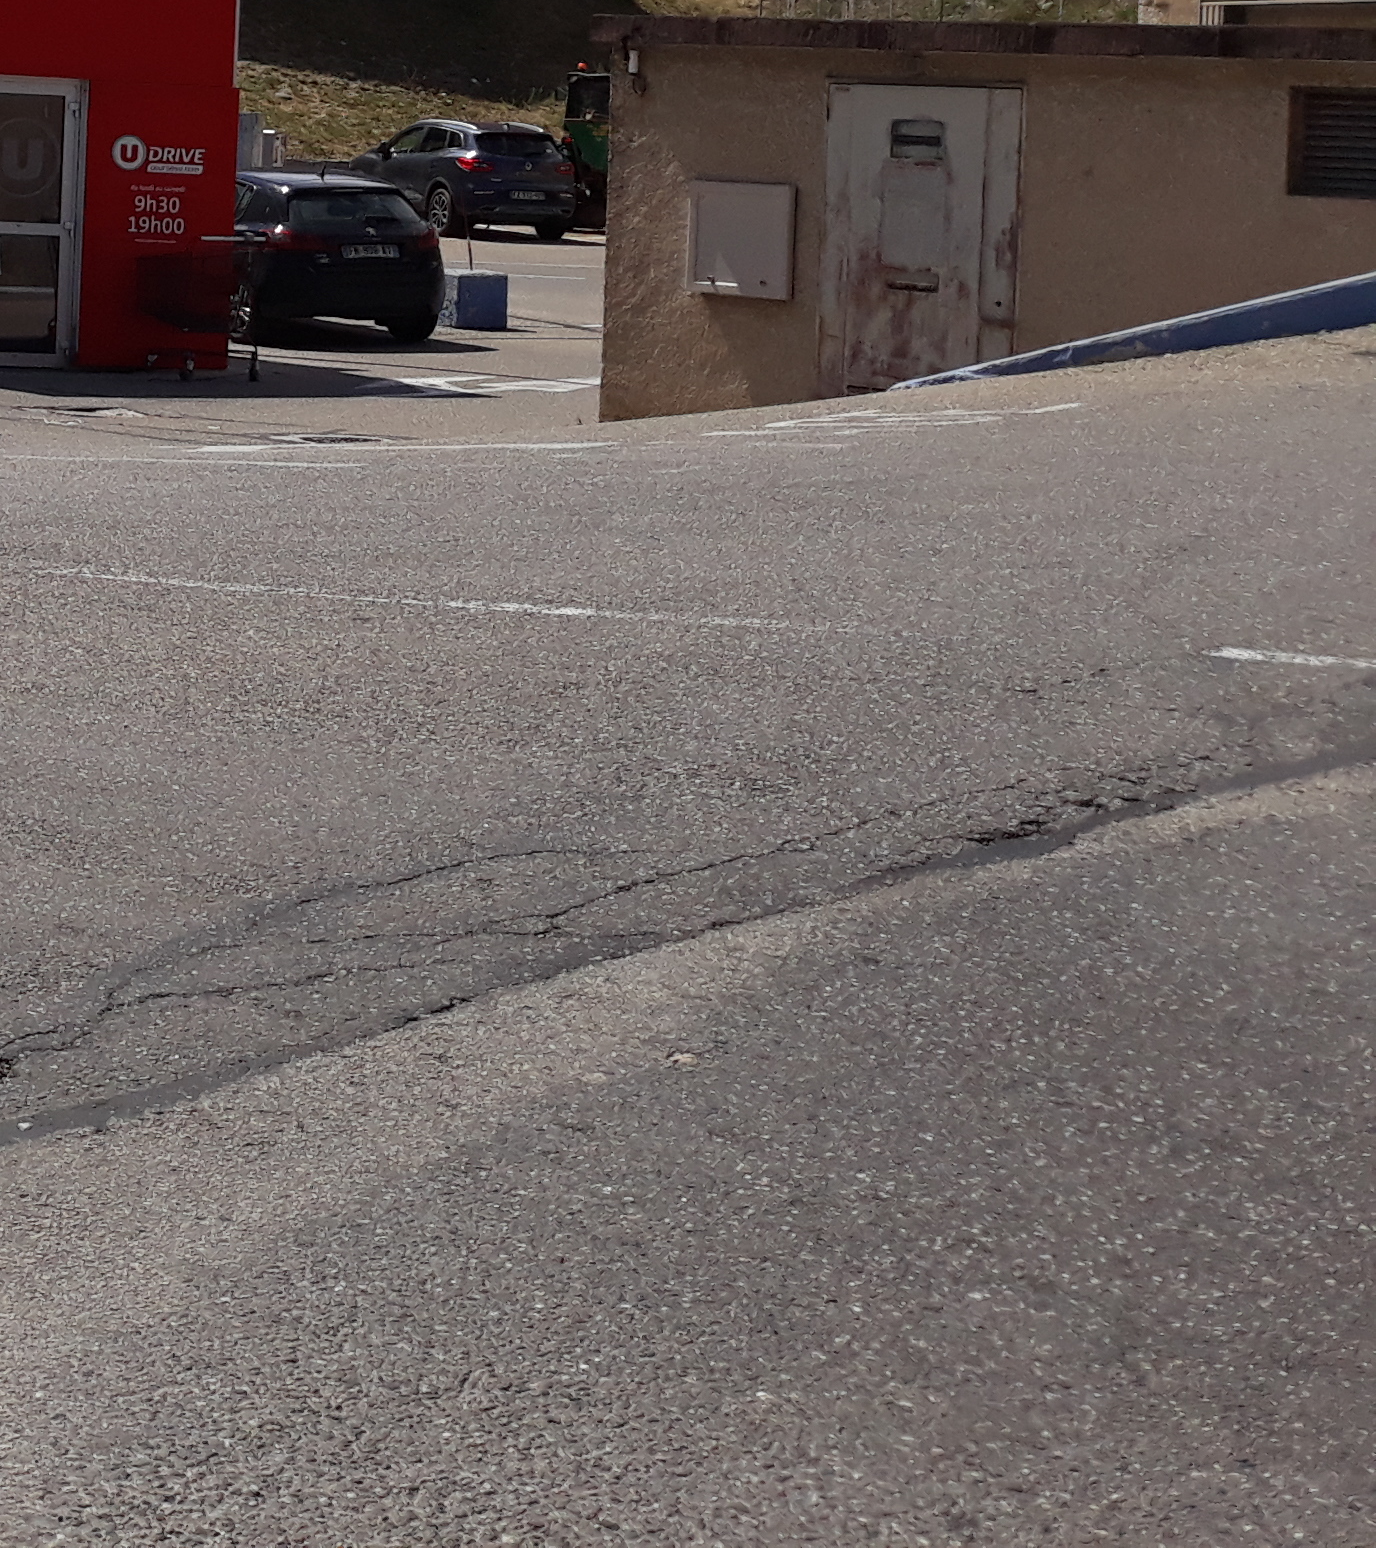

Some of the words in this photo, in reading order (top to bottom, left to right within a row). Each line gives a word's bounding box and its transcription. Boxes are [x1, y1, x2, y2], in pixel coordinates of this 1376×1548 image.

[120, 143, 140, 164] U
[148, 146, 206, 164] DRIVE
[134, 194, 180, 213] 9h30
[128, 214, 185, 234] 19h00
